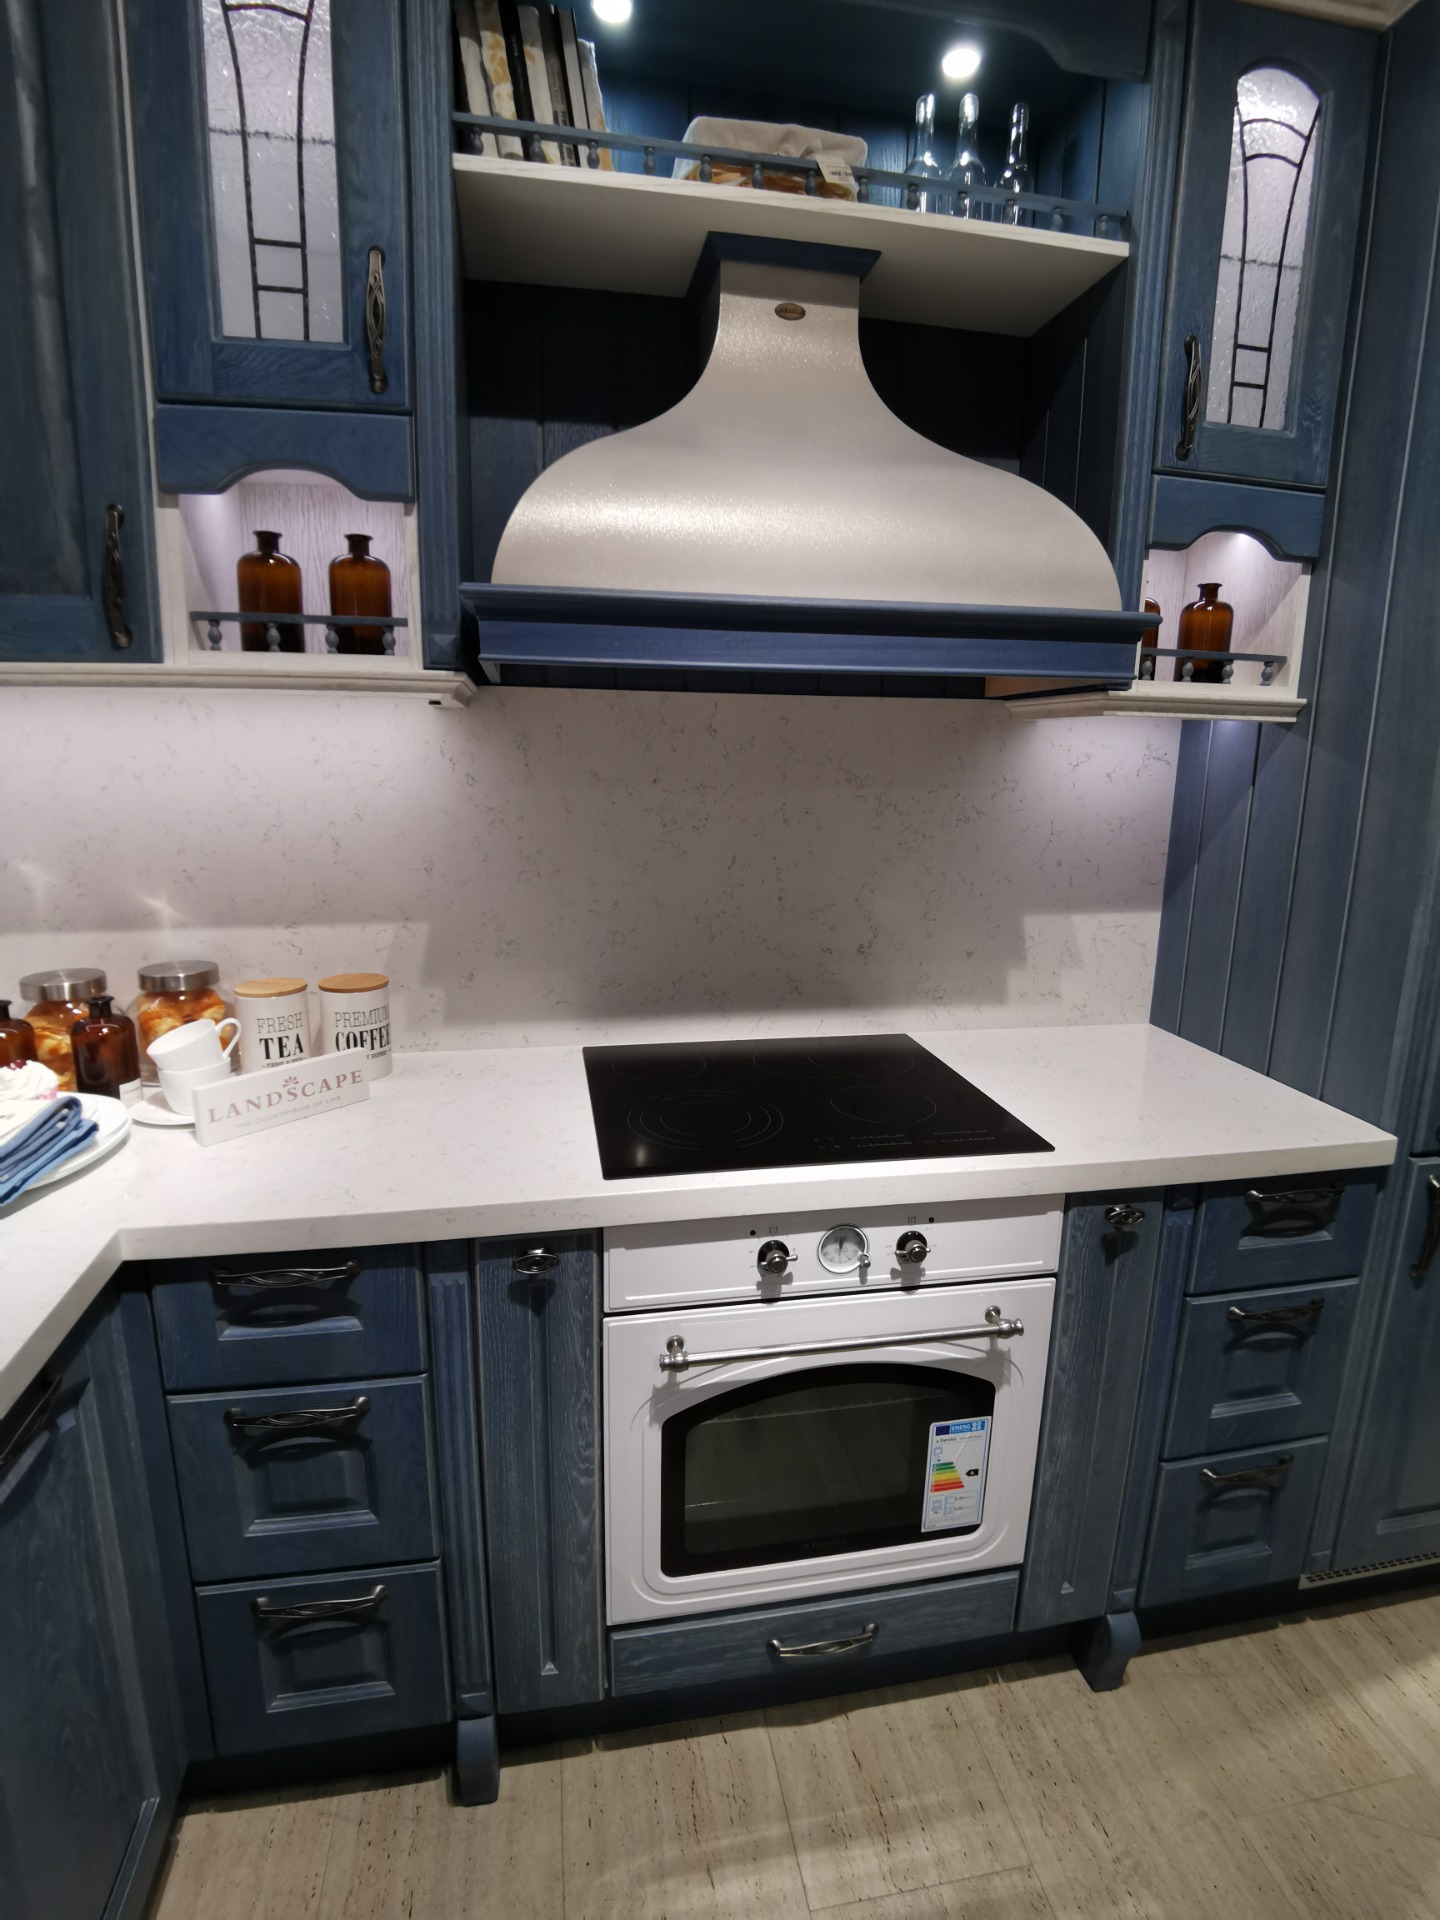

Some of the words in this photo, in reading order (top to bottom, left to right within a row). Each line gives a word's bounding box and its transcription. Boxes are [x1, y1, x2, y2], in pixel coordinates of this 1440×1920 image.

[256, 1011, 304, 1034] FRESH
[335, 1022, 392, 1052] COFFEE
[259, 1032, 304, 1060] TEA
[207, 1069, 364, 1124] LANDSCAPE
[236, 1120, 251, 1128] THE
[255, 1104, 310, 1124] COUNTRYSIDE
[313, 1100, 323, 1108] OF
[326, 1095, 342, 1105] LIFE
